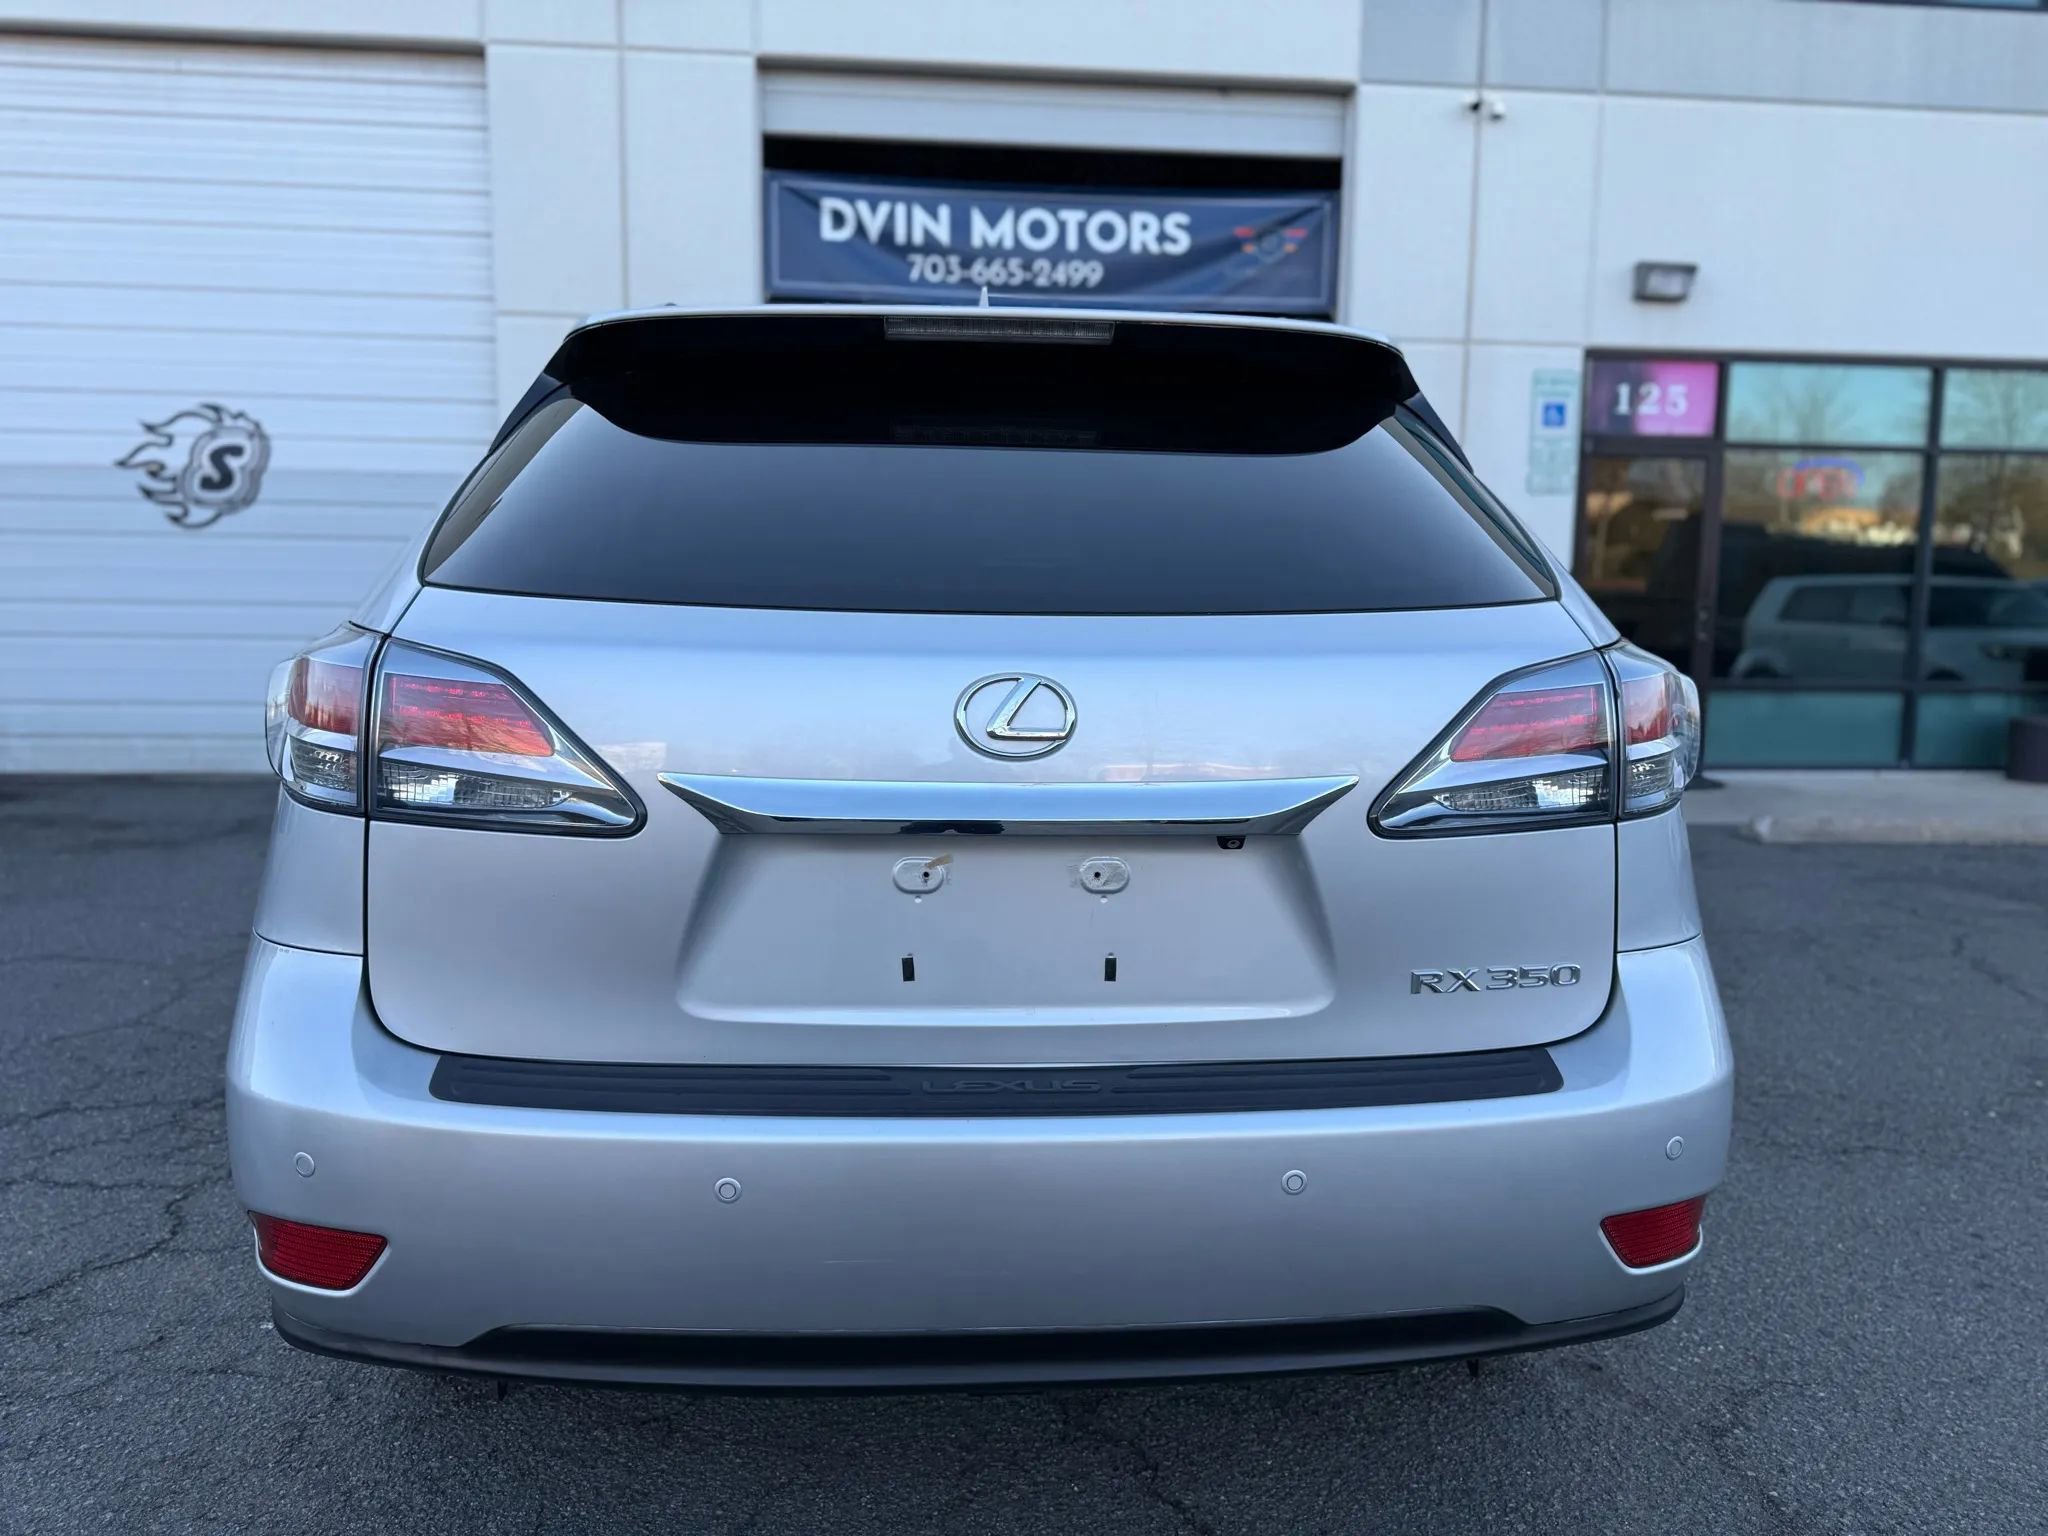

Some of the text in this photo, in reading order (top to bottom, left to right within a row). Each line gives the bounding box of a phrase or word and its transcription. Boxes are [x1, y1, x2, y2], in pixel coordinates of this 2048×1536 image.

[819, 196, 1192, 254] DVIN MOTORS
[907, 254, 1104, 288] 703-665-2499
[1615, 382, 1688, 417] 125
[199, 445, 244, 491] S
[1410, 962, 1581, 994] RX 350
[921, 1079, 1101, 1094] LEXUS
